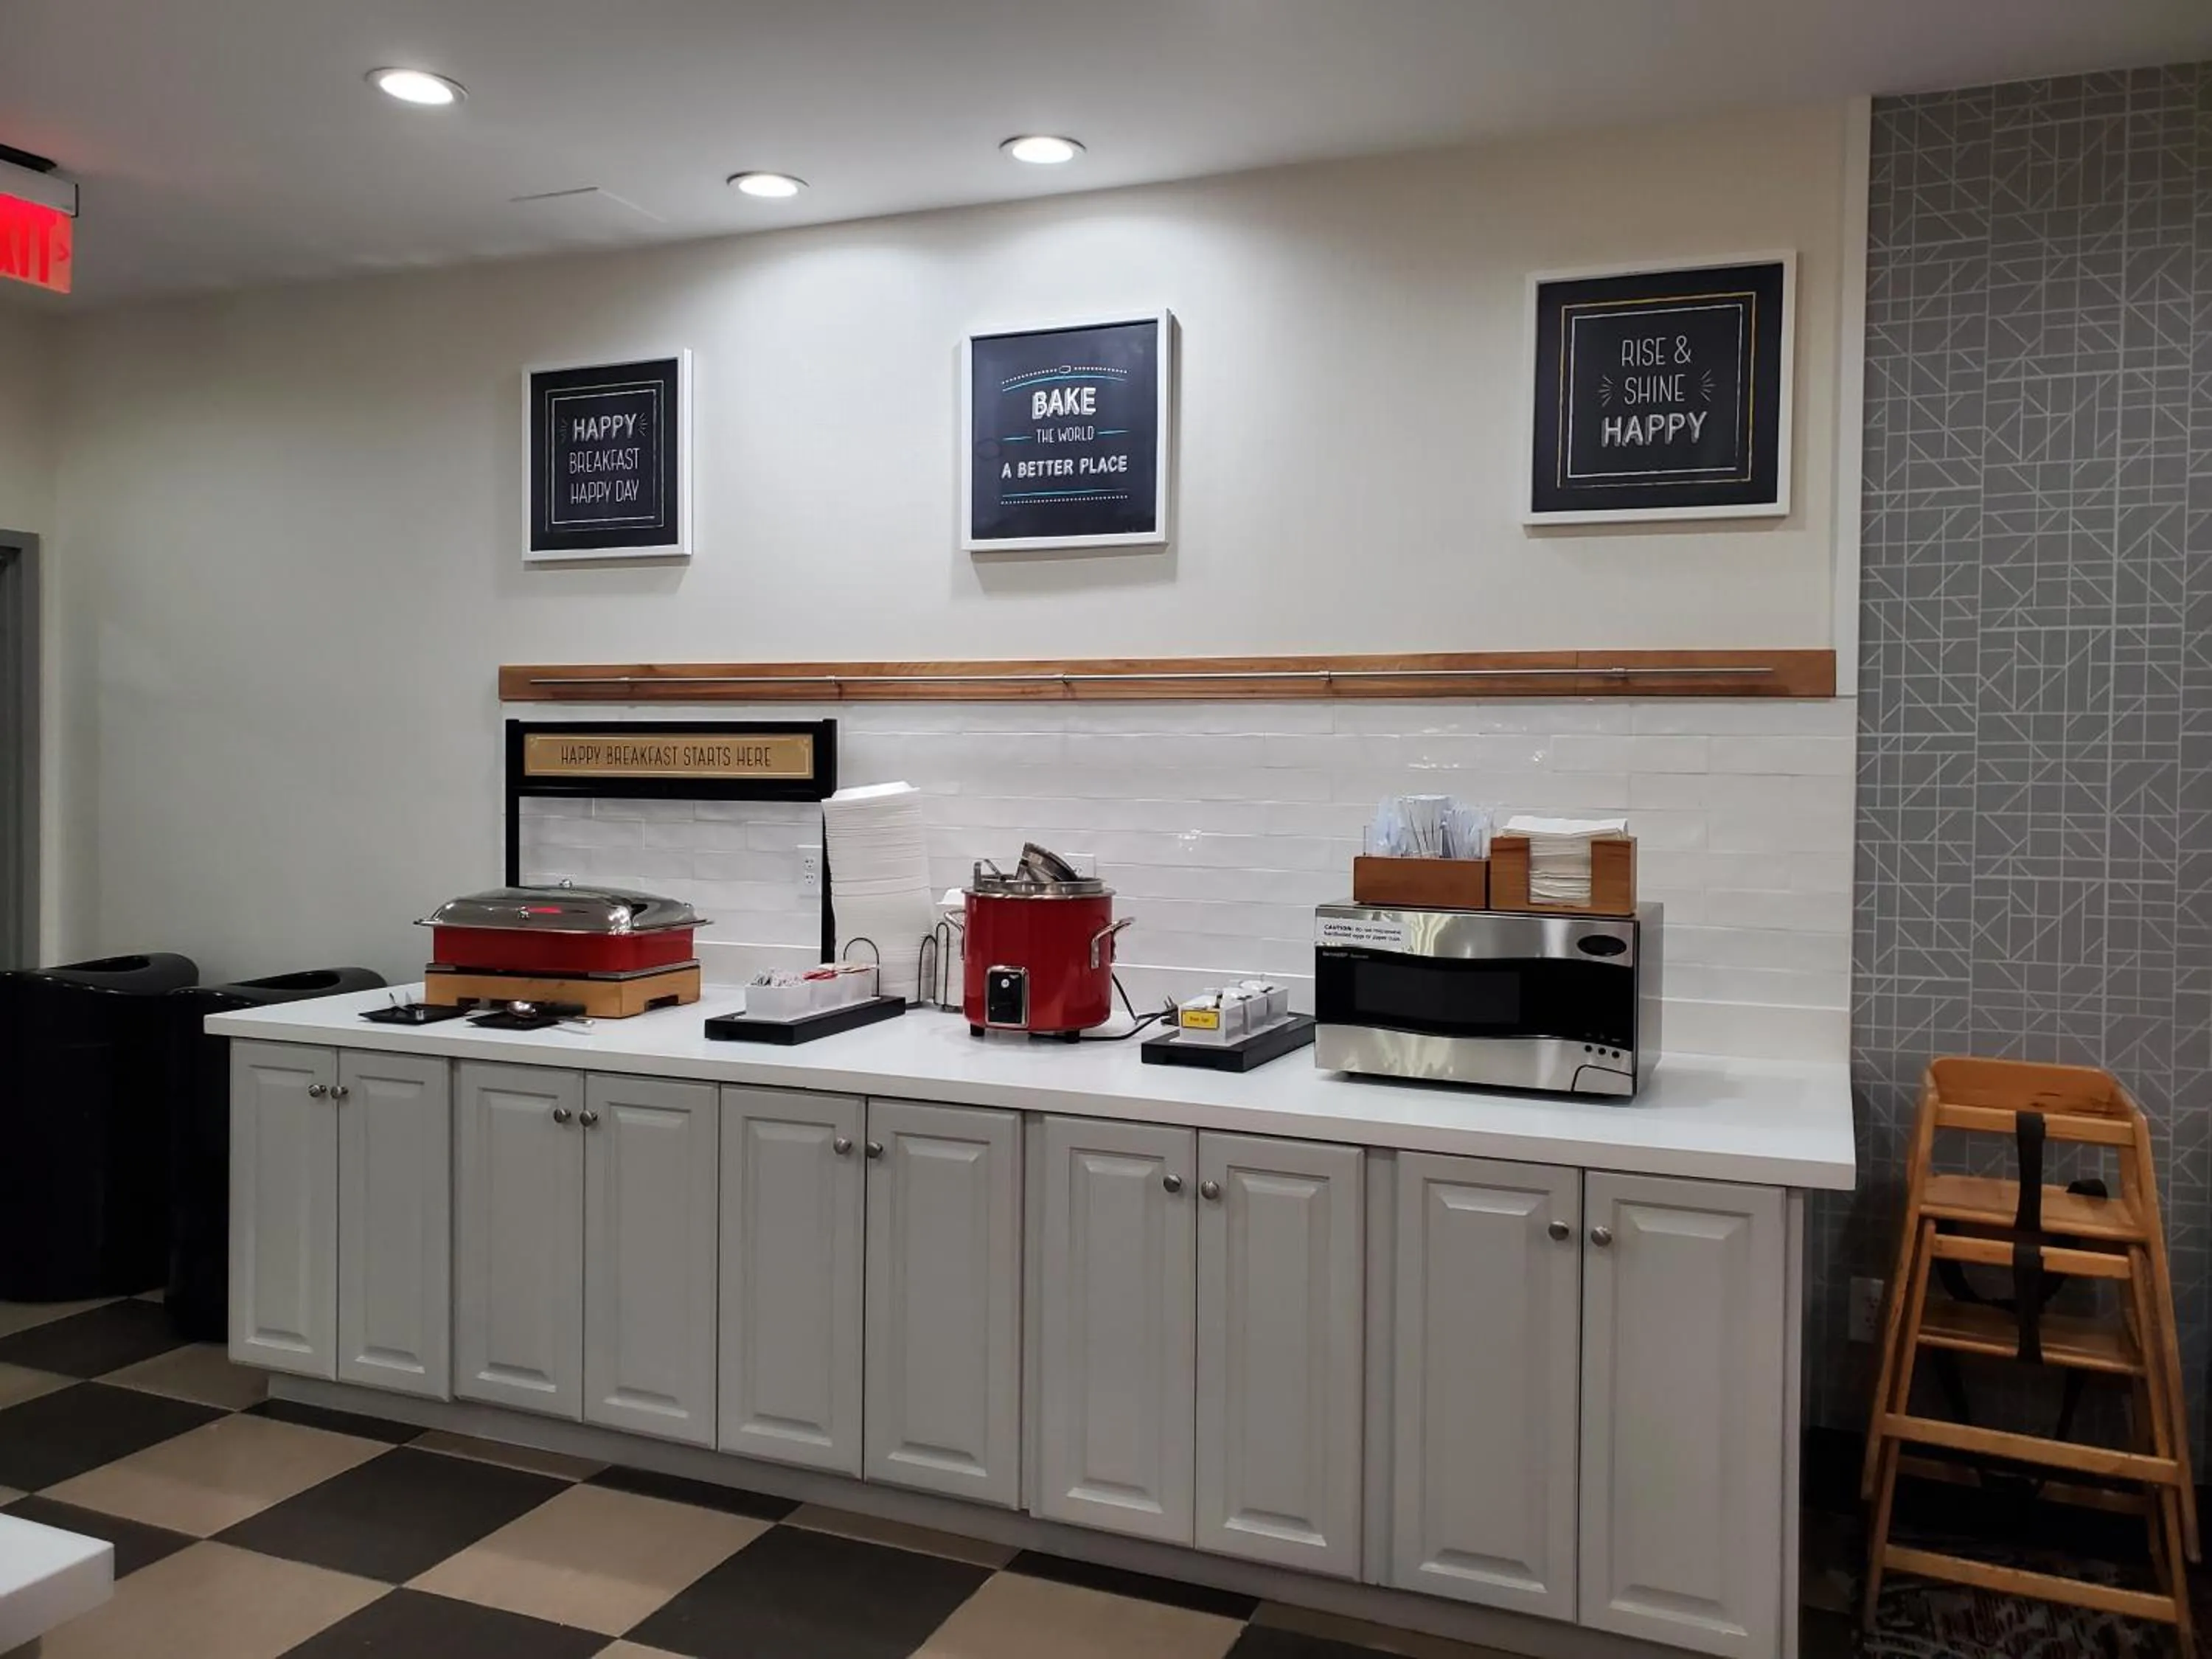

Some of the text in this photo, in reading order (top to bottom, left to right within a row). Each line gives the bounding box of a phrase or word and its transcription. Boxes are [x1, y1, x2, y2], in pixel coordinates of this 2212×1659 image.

[1621, 335, 1692, 366] RISE &
[1624, 373, 1686, 405] SHINE
[1032, 387, 1096, 420] BAKE
[572, 413, 638, 442] HAPPY
[1036, 425, 1094, 444] THE WORLD
[1601, 411, 1708, 447] HAPPY
[569, 448, 640, 473] BREAKFAST
[1001, 455, 1128, 479] A BETTER PLACE
[570, 479, 640, 504] HAPPY DAY
[560, 745, 772, 767] HAPPY BREAKFAST STARTS HERE
